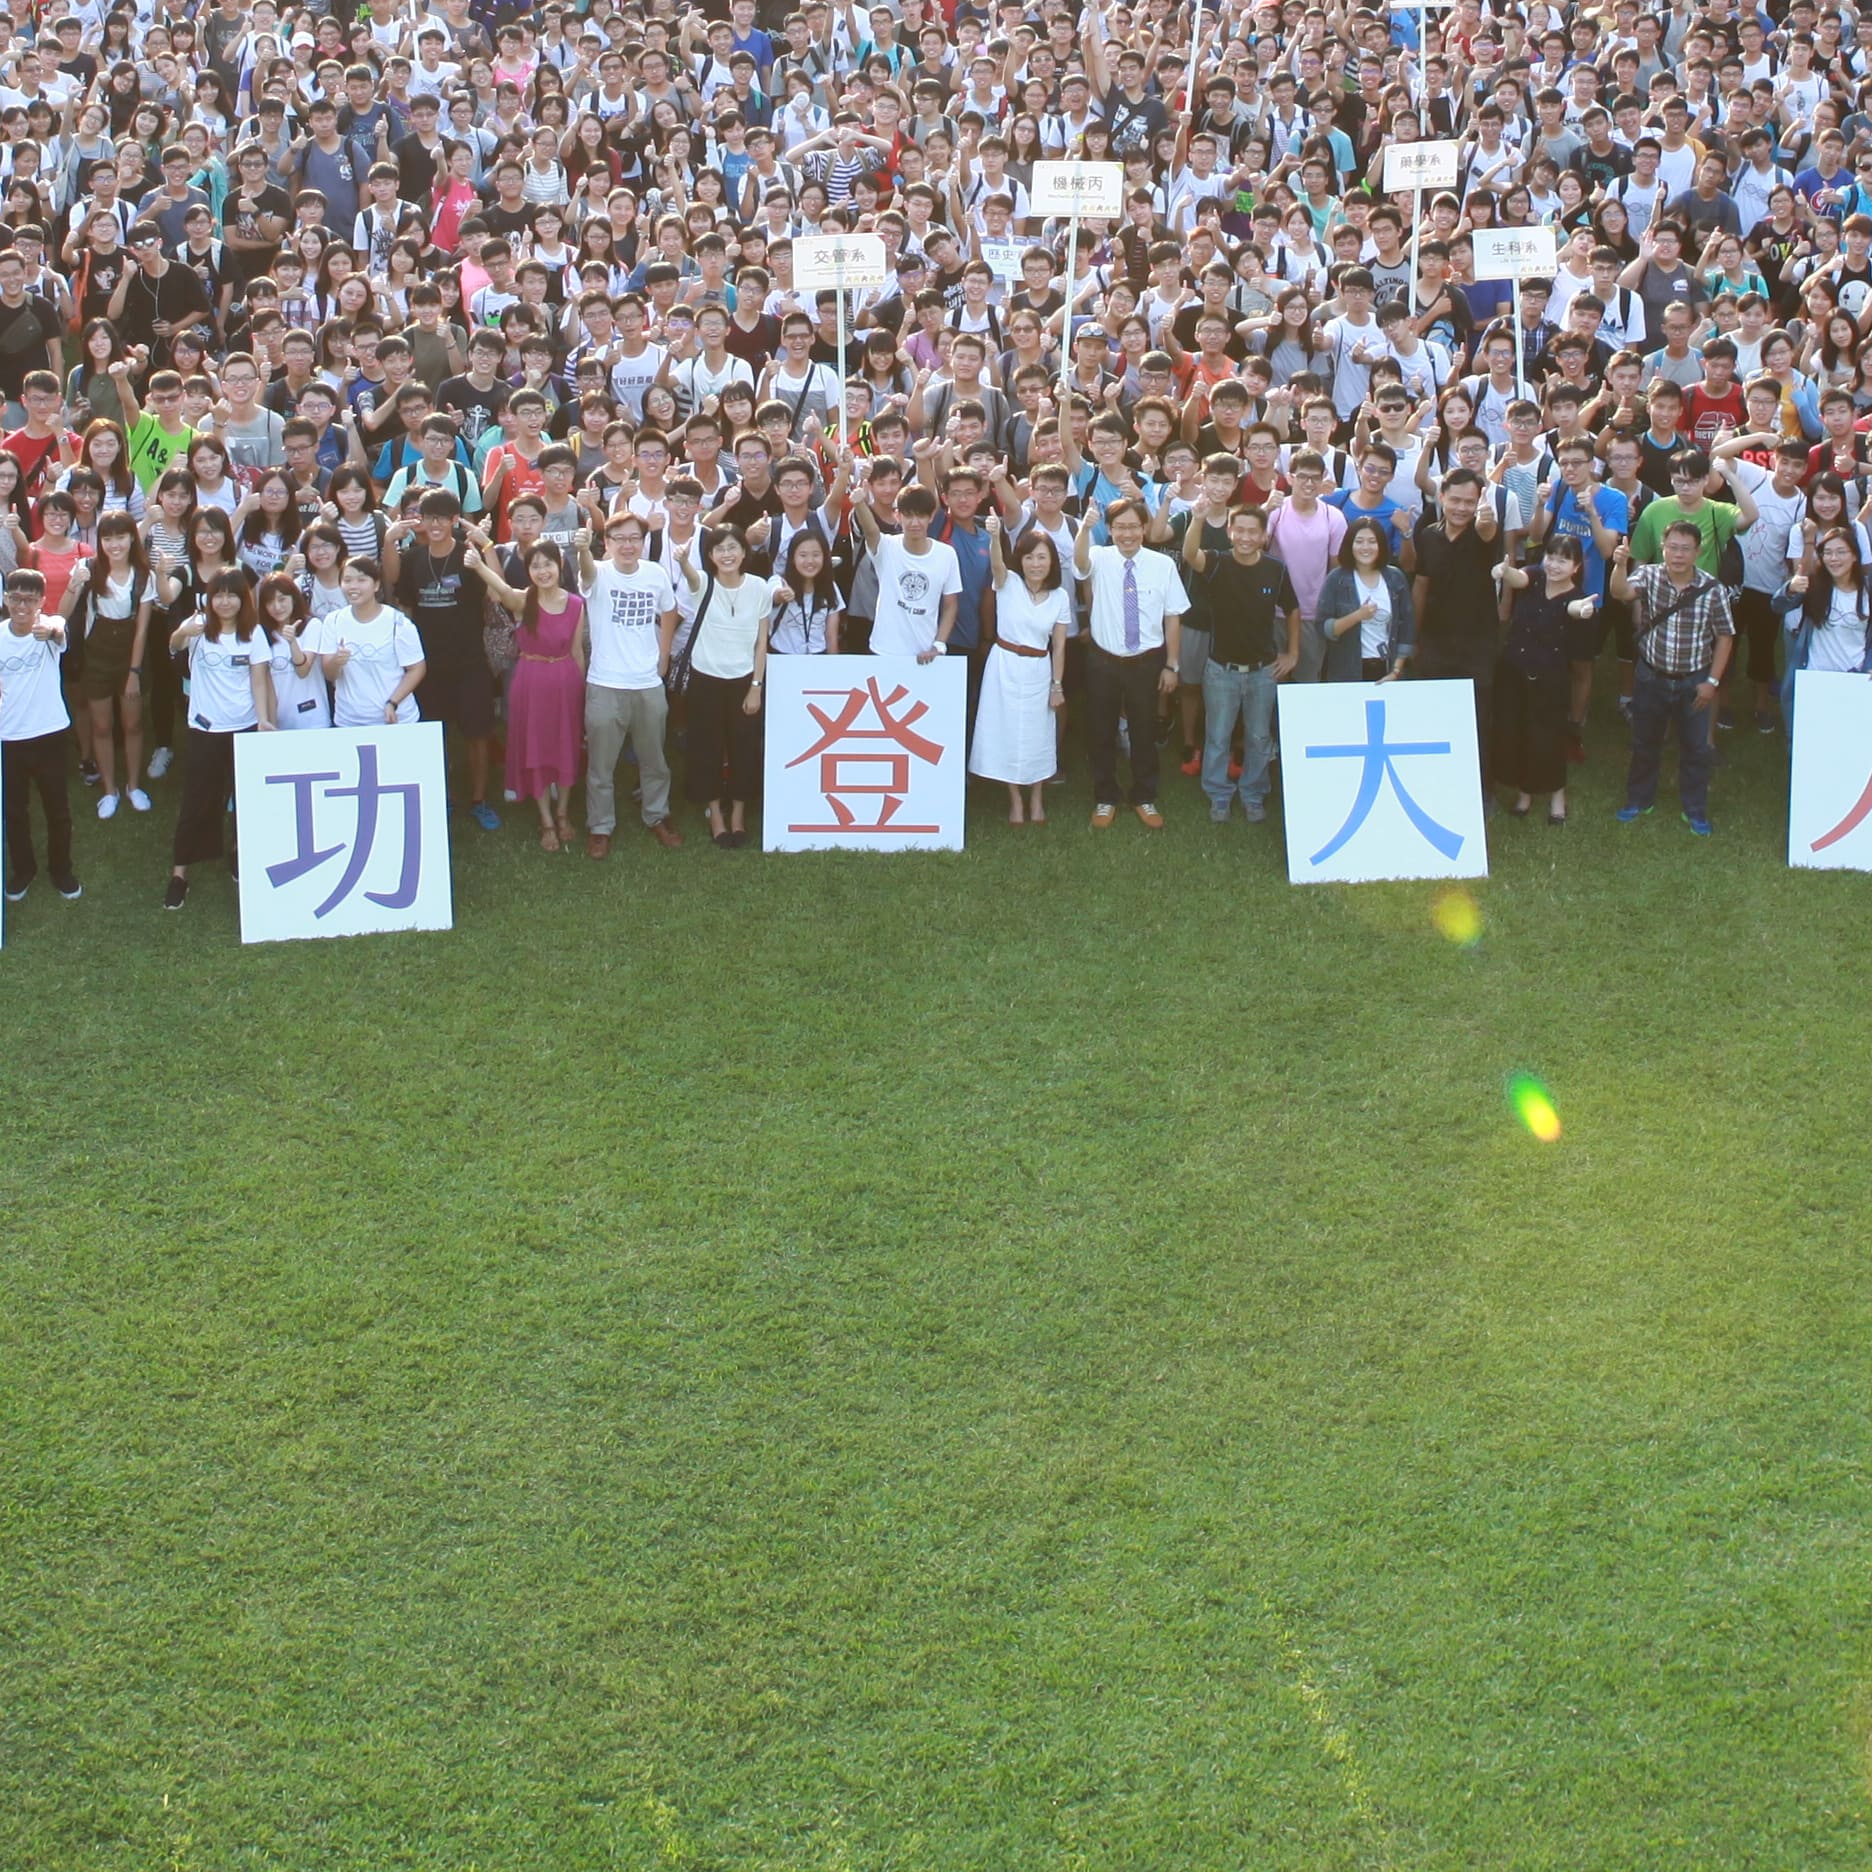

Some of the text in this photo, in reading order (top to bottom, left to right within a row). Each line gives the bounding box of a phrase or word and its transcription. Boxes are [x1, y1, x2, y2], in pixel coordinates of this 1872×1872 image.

[1052, 175, 1104, 192] 機械丙
[814, 248, 867, 265] 交管系
[988, 247, 1020, 261] 歷史
[1491, 240, 1538, 256] 生科系
[1558, 518, 1592, 537] PUMA
[785, 675, 945, 834] 登
[1305, 699, 1466, 867] 大
[263, 744, 421, 919] 功
